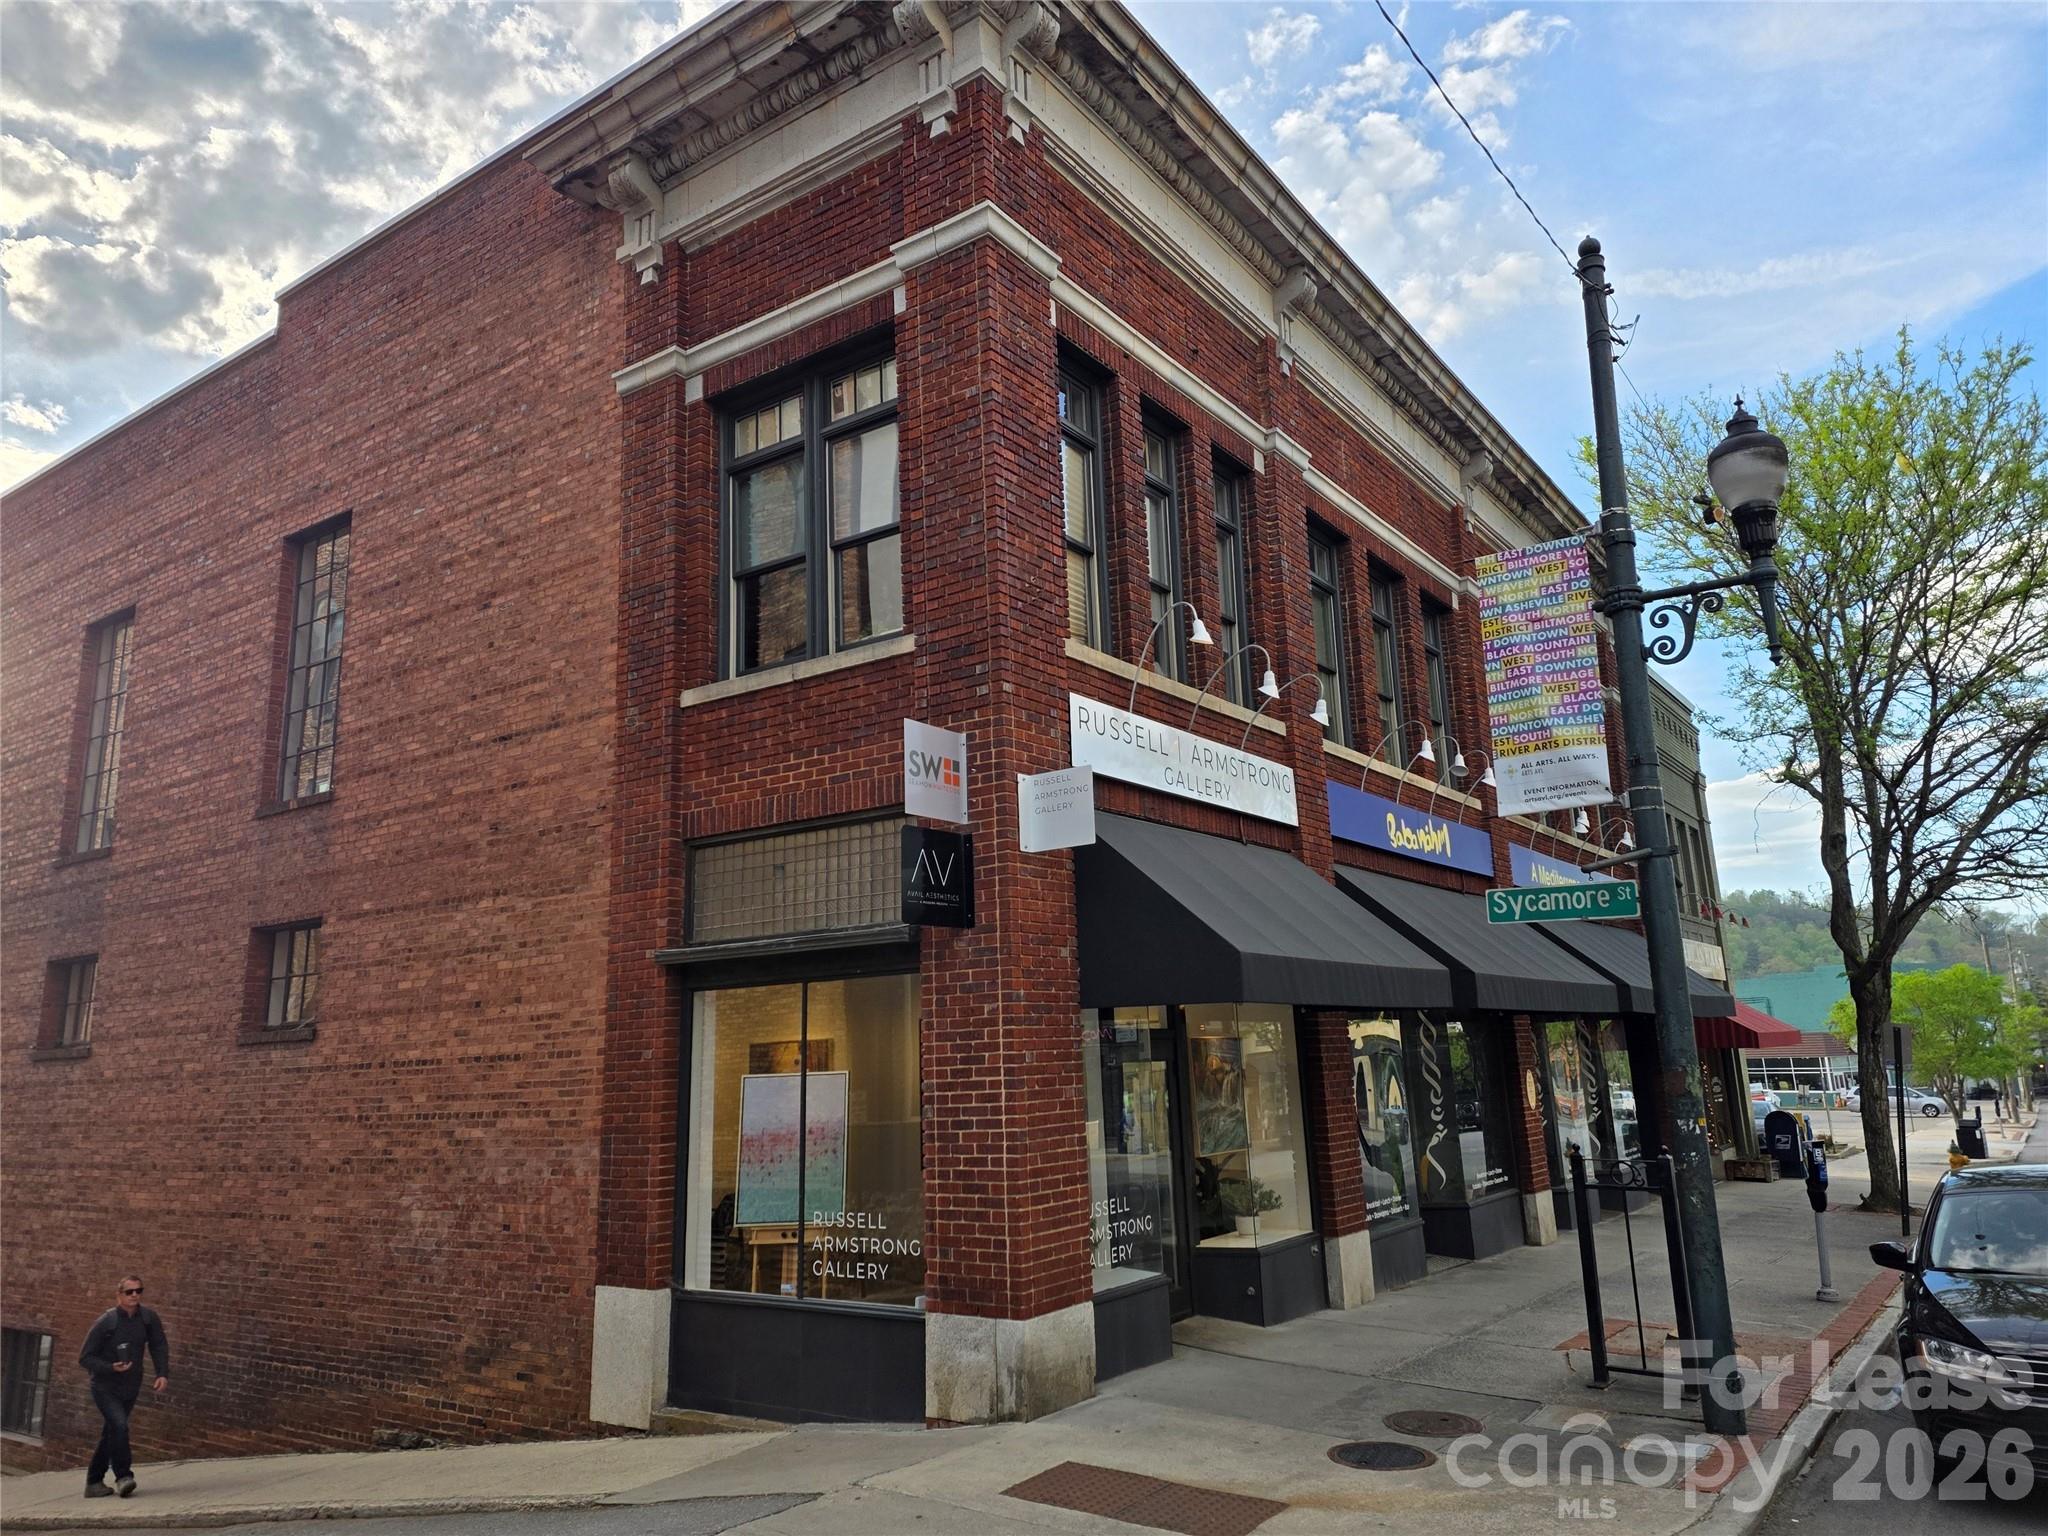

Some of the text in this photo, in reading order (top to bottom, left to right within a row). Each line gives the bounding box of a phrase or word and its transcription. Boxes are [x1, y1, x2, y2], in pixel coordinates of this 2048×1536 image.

[1497, 548, 1523, 562] EAST
[1507, 551, 1562, 570] BILTMORE
[1535, 561, 1566, 575] WEST
[1485, 573, 1561, 596] WEAVERVILLE
[1498, 588, 1539, 604] NORTH
[1541, 583, 1569, 596] EAST
[1571, 579, 1590, 590] DO
[1502, 609, 1541, 624] SOUTH
[1541, 602, 1585, 617] NORTH
[1505, 594, 1564, 613] ASHEVILLE
[1484, 611, 1591, 639] DISTRICT BILTMORE
[1486, 645, 1521, 660] BLACK
[1523, 634, 1591, 653] MOUNTAIN
[1493, 627, 1569, 648] DOWNTOWN
[1502, 654, 1532, 668] WEST
[1534, 648, 1576, 662] SOUTH
[1490, 668, 1595, 693] BILTMORE VILLAGE
[1507, 665, 1533, 678] EAST
[1544, 682, 1577, 694] WEST
[1563, 690, 1602, 703] BLACK
[1509, 706, 1549, 721] NORTH
[1550, 704, 1580, 716] EAST
[1582, 702, 1602, 712] DO
[1491, 715, 1564, 737] DOWNTOWN
[1512, 728, 1550, 745] SOUTH
[1551, 724, 1597, 737] NORTH
[1078, 705, 1169, 757] RUSSELL
[1191, 744, 1292, 795] ARMSTRONG
[1499, 744, 1530, 758] RIVER
[1533, 739, 1560, 752] ARTS
[908, 750, 943, 783] SW
[1520, 762, 1534, 770] ALL
[1557, 755, 1571, 763] ALL
[1033, 774, 1072, 786] RUSSELL
[1164, 766, 1232, 800] GALLERY
[1034, 784, 1089, 801] ARMSTRONG
[1523, 786, 1546, 796] EVENT
[1034, 802, 1073, 815] GALLERY
[1493, 886, 1632, 920] Sycamore St
[813, 1211, 887, 1229] RUSSELL
[812, 1235, 921, 1257] ARMSTRONG
[812, 1260, 889, 1280] GALLERY
